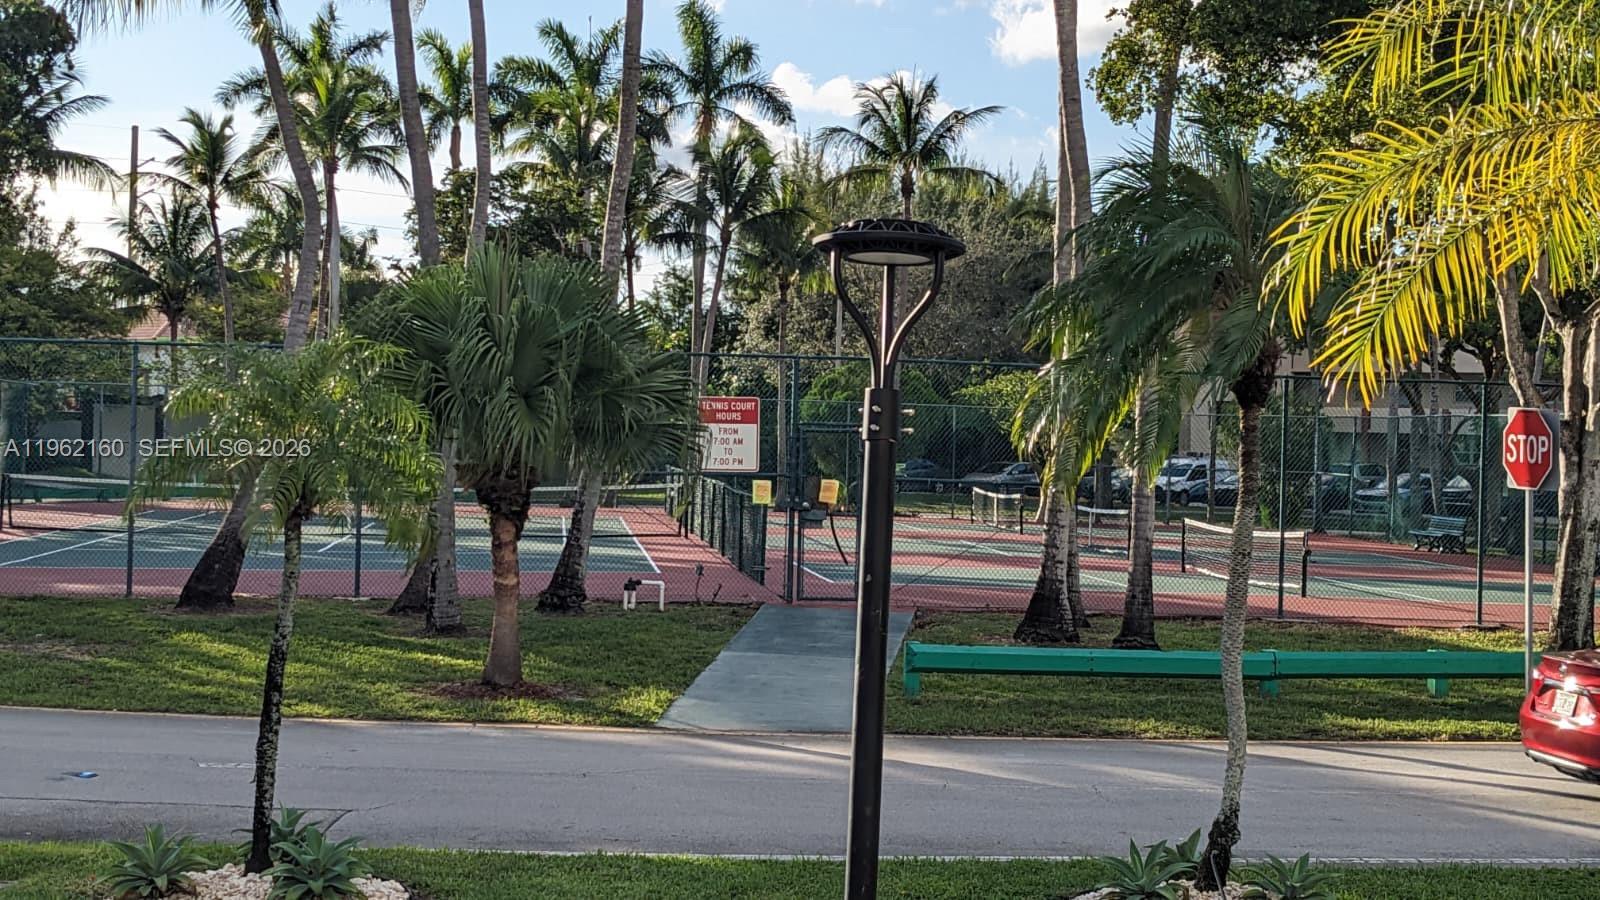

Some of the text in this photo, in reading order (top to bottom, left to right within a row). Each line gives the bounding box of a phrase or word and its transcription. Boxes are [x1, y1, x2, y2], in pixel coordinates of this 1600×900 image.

[731, 402, 755, 410] COURT
[716, 412, 741, 420] HOURS
[1506, 433, 1549, 464] STOP
